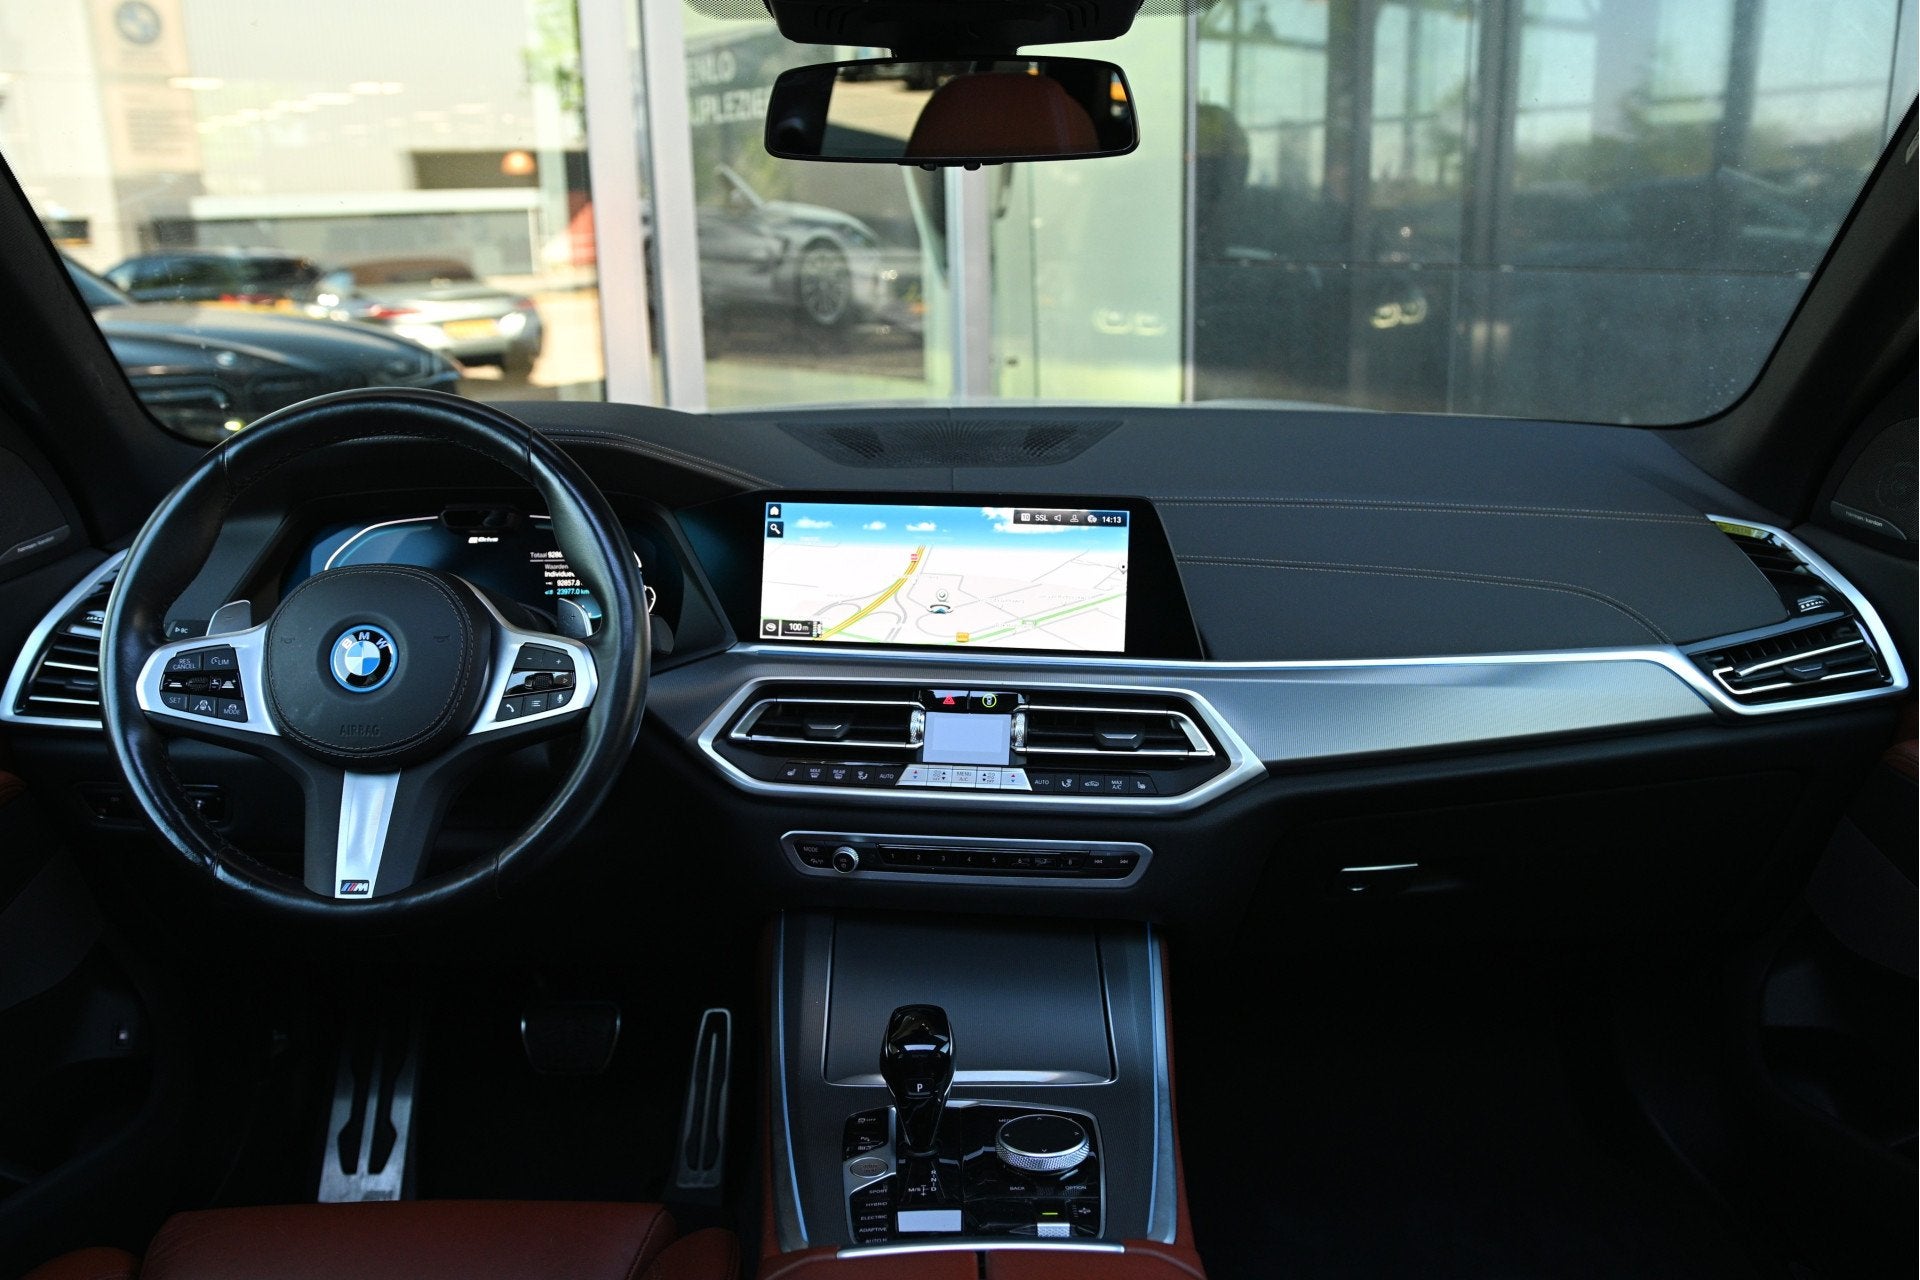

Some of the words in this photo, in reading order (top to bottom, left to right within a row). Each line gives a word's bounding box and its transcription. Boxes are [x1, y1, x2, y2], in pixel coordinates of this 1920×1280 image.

[1035, 514, 1048, 522] SSL
[1102, 516, 1121, 524] 14:13
[789, 622, 803, 631] 100
[341, 631, 389, 650] BMW
[339, 723, 381, 736] AIRBAG
[916, 1083, 923, 1093] P
